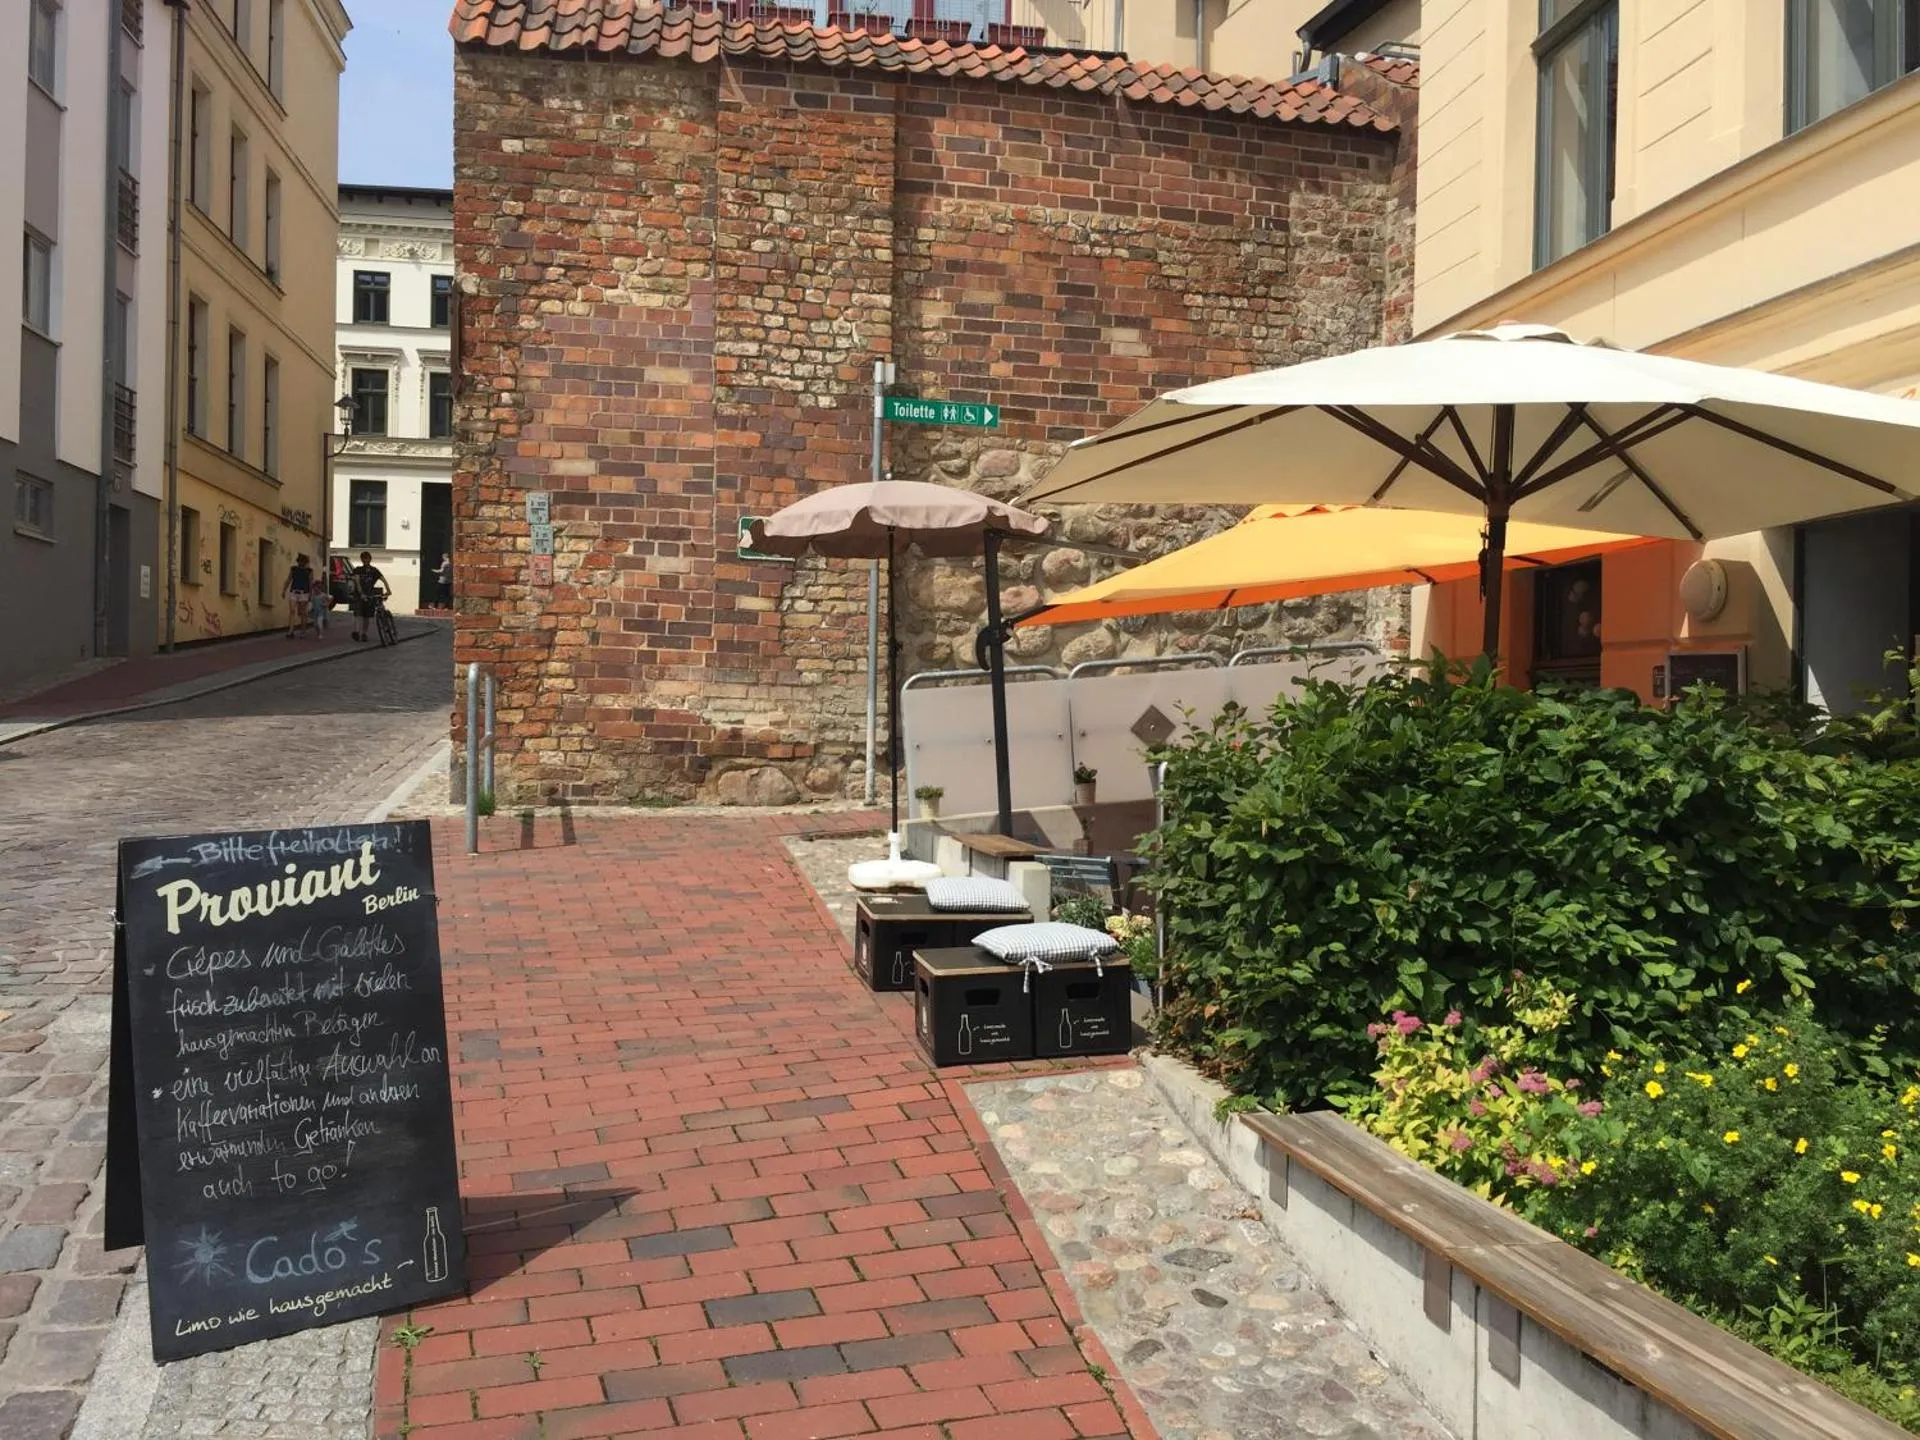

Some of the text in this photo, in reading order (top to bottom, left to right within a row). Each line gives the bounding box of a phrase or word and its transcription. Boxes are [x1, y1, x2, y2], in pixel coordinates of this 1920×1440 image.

[893, 402, 936, 419] Toilette
[156, 840, 382, 935] Proviant
[362, 885, 421, 915] Berlin
[166, 988, 222, 1033] frisch
[421, 1046, 442, 1064] an
[202, 1163, 253, 1199] auch
[271, 1159, 297, 1193] to
[174, 1272, 393, 1337] Limo wie hausgemacht
